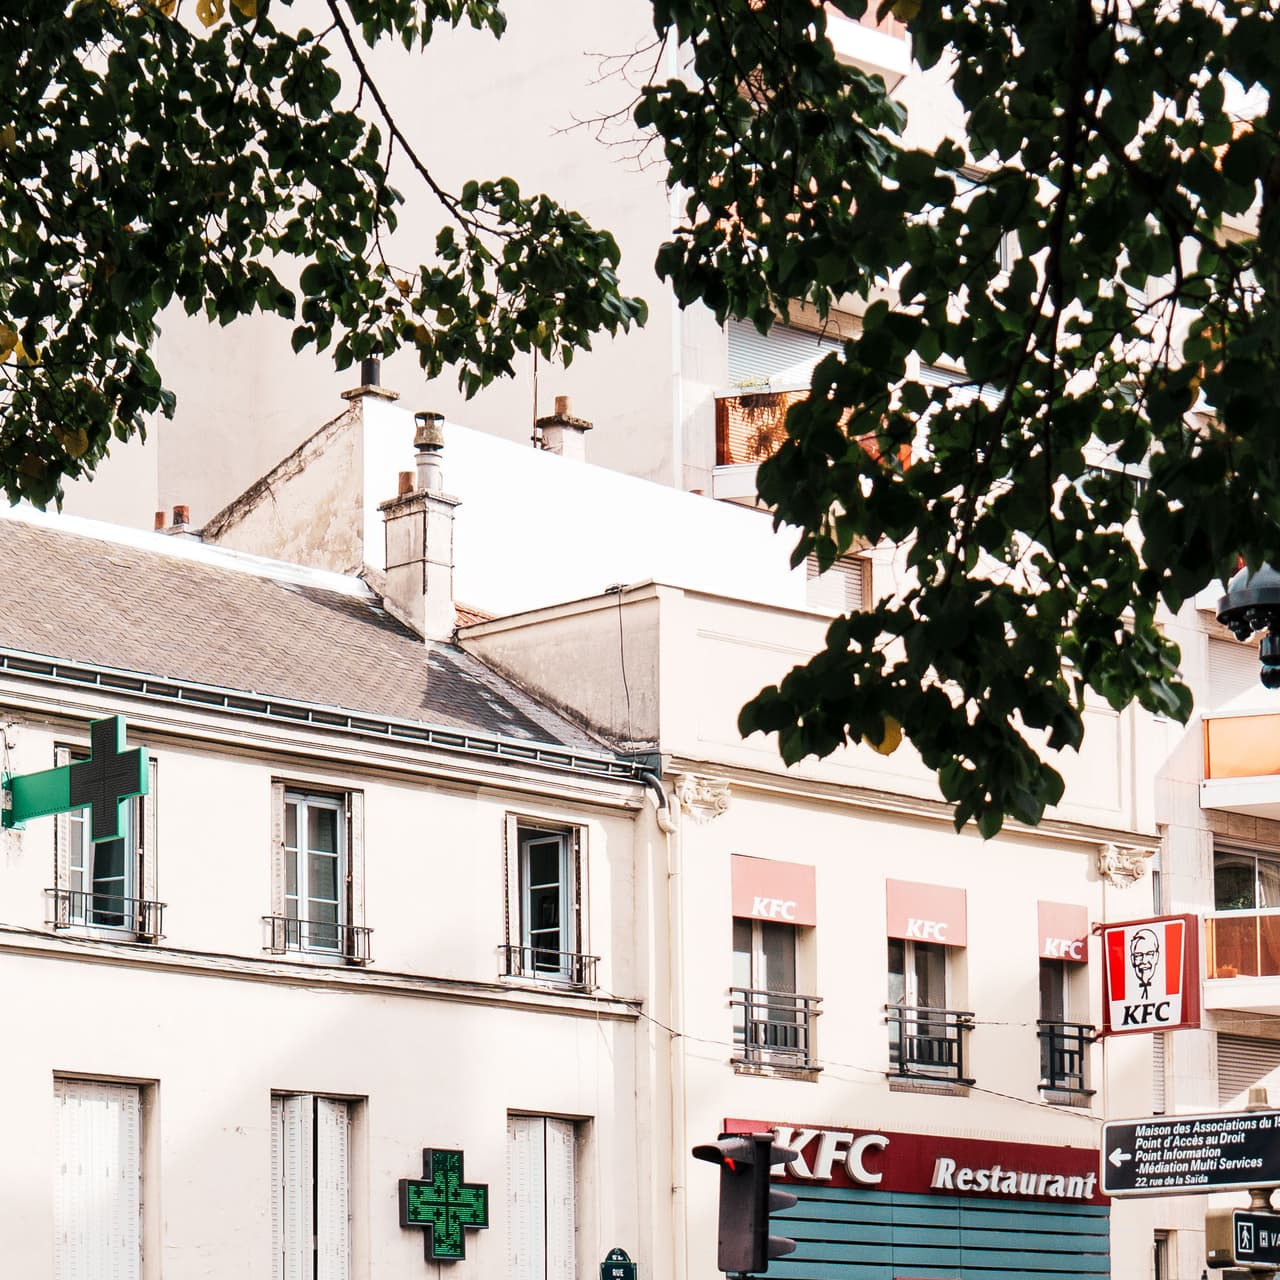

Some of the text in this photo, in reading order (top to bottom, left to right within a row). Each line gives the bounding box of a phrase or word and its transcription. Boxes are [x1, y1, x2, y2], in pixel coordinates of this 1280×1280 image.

[751, 896, 797, 920] KFC
[905, 918, 948, 941] KFC
[1043, 937, 1083, 960] KFC
[1122, 1001, 1170, 1026] KFC
[1135, 1122, 1171, 1136] Maison
[1173, 1121, 1191, 1134] des
[1192, 1116, 1257, 1133] Associations
[1259, 1115, 1272, 1128] du
[1135, 1131, 1245, 1149] Point d'Accès au Droit
[771, 1126, 1097, 1200] KFC Restaurant
[1135, 1147, 1221, 1162] Point Information
[1135, 1156, 1263, 1175] -Médiation Multi Services
[1149, 1177, 1162, 1186] rue
[1164, 1176, 1174, 1185] de
[1175, 1175, 1183, 1184] la
[1185, 1174, 1208, 1184] Saïda
[612, 1268, 625, 1277] RUE
